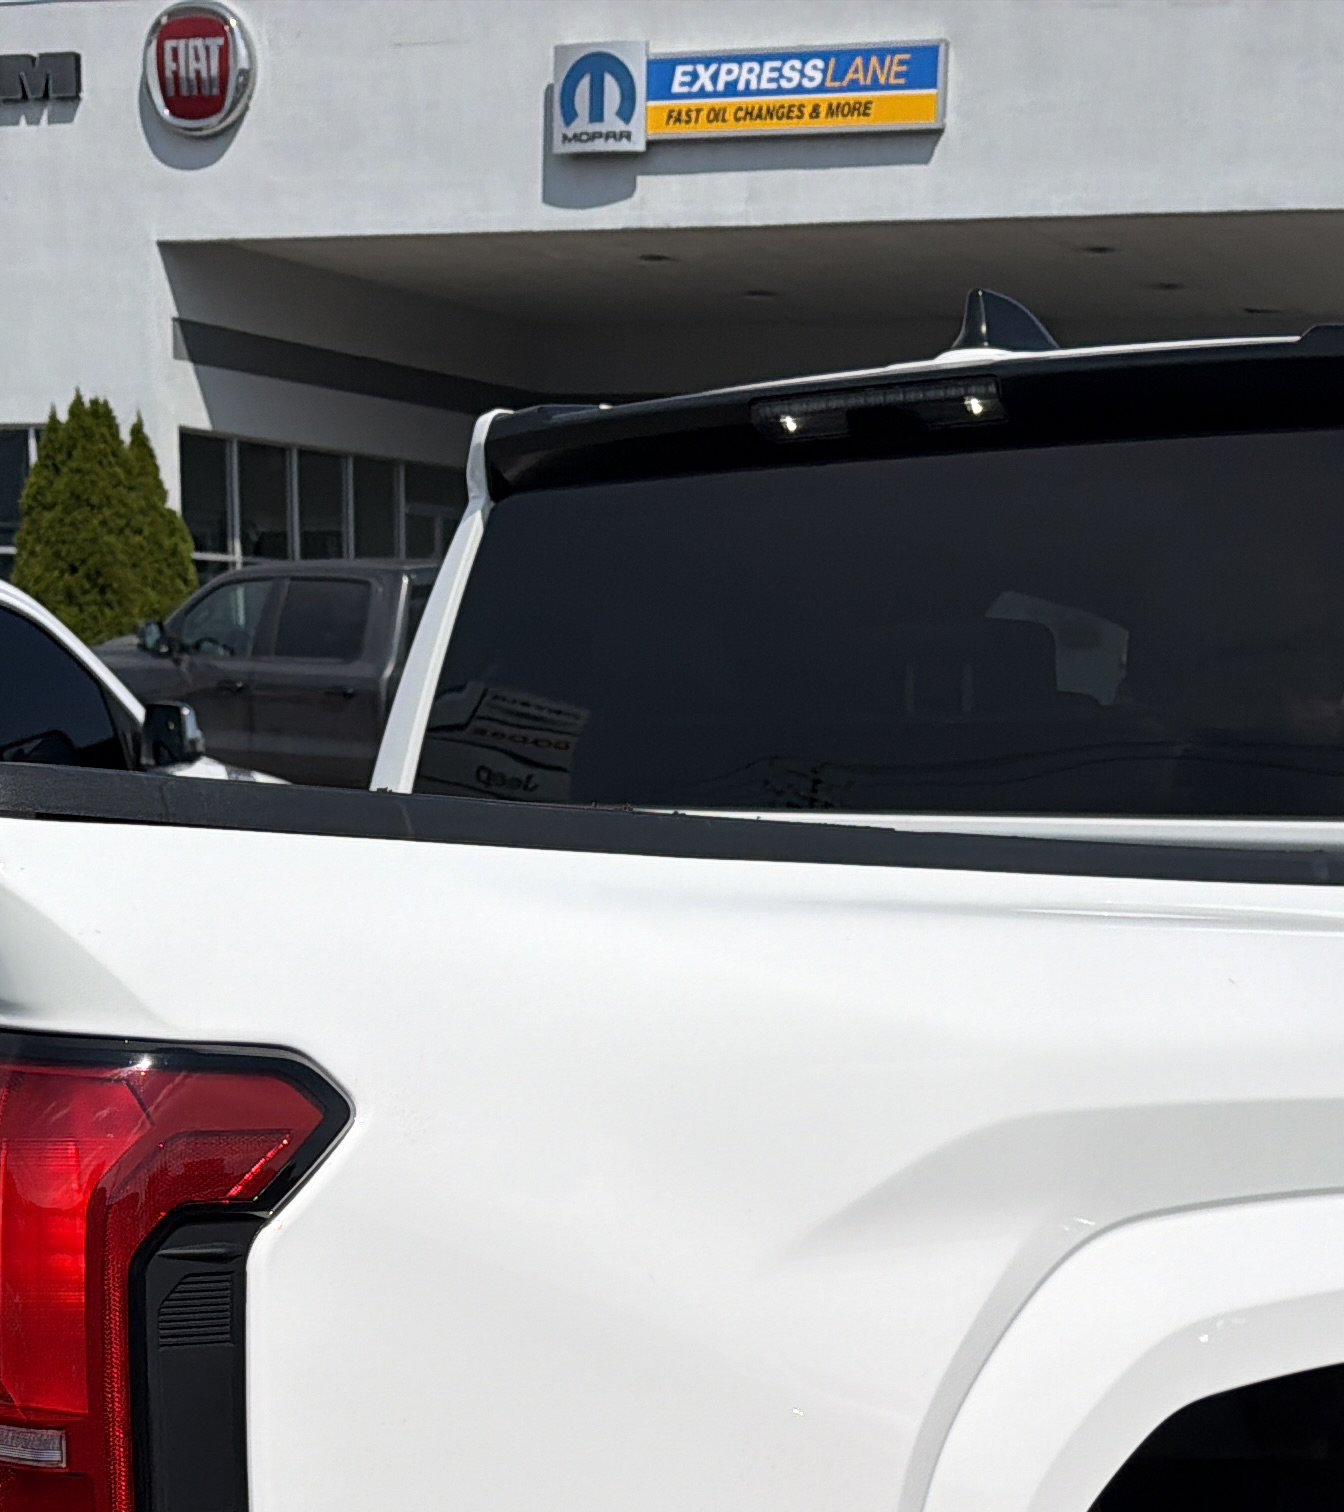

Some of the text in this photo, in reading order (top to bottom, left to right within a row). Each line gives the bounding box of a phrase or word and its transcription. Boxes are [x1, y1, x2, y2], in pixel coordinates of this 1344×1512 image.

[164, 37, 225, 98] FIAT
[665, 100, 874, 126] FAST OIL CHANGES & MORE
[561, 130, 632, 145] MOPAR
